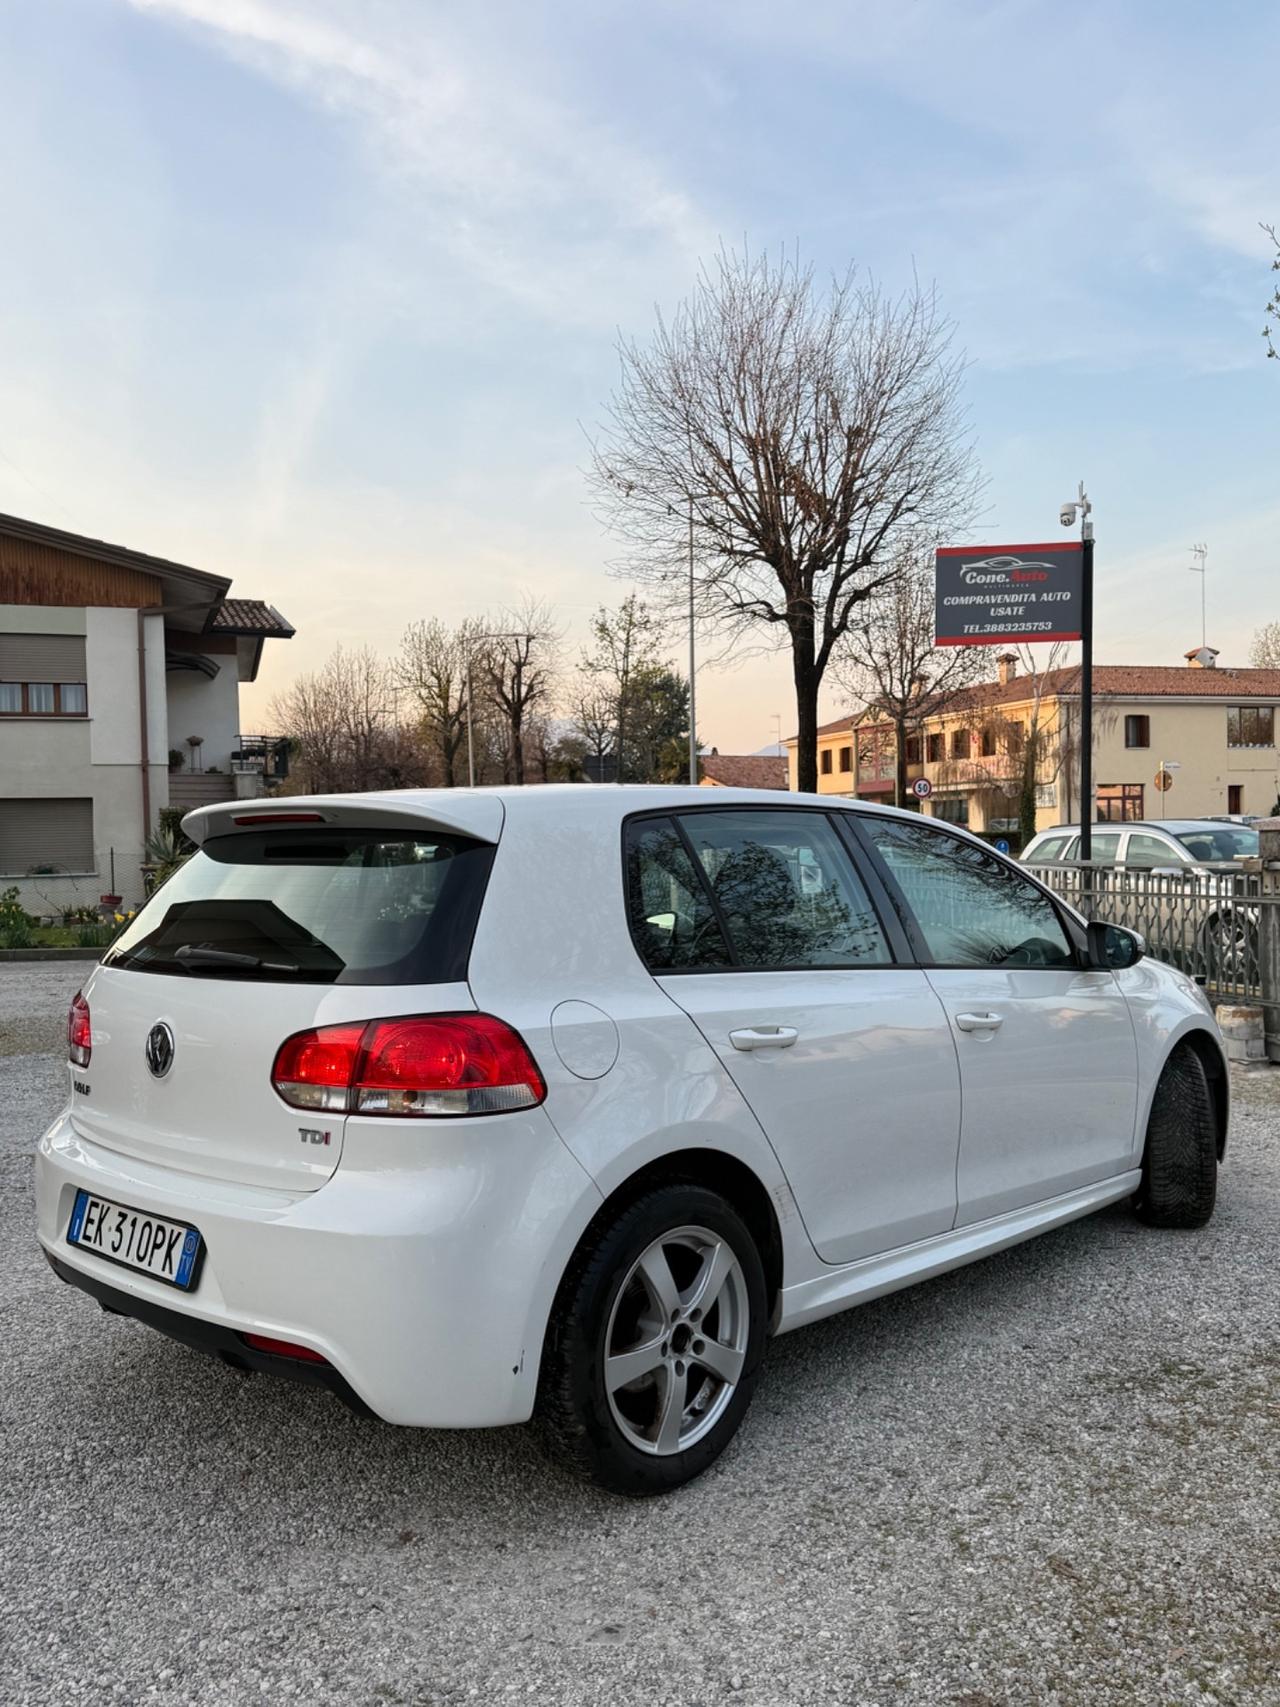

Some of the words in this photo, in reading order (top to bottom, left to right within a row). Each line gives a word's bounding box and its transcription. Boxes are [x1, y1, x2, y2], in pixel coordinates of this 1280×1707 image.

[943, 593, 1036, 606] COMPRAVENDITA
[1040, 592, 1071, 602] AUTO
[989, 606, 1026, 617] USATE
[964, 622, 1052, 633] TEL.3883235753
[917, 782, 928, 793] 50
[298, 1128, 331, 1146] TDI
